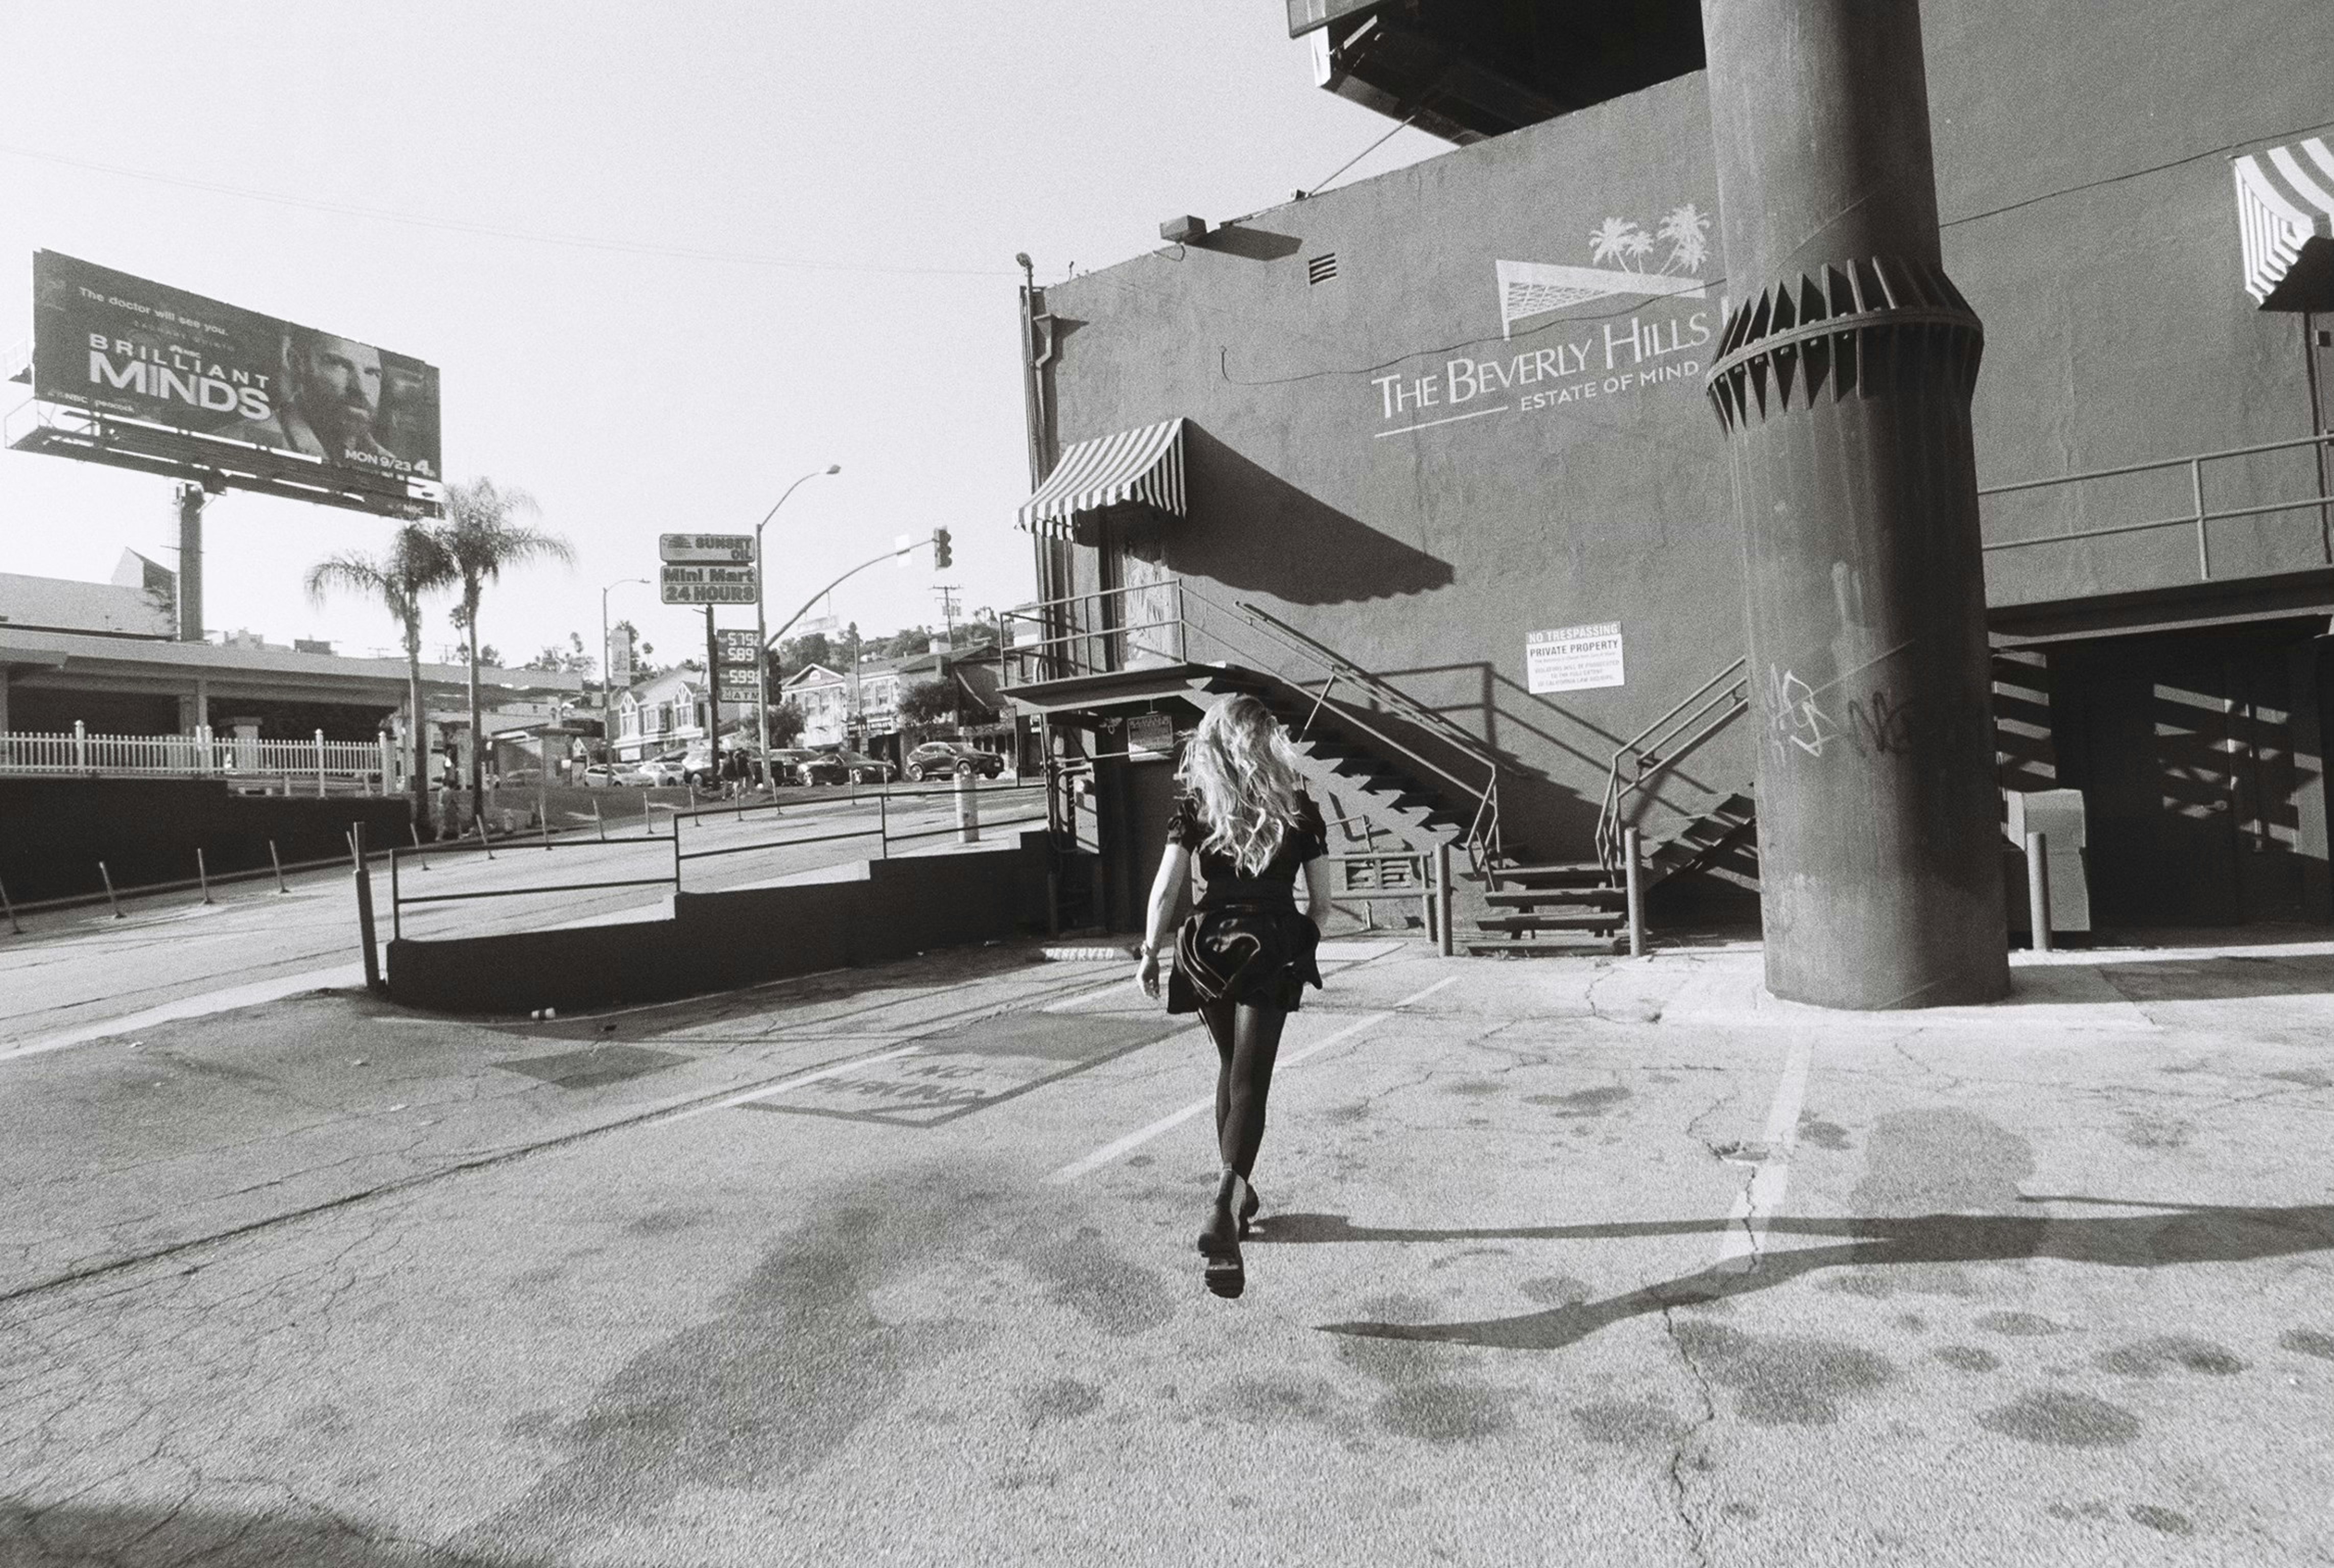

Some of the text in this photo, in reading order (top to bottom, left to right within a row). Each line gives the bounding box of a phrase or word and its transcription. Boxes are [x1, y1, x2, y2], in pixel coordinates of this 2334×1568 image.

[80, 287, 229, 336] The doctor will see you.
[90, 333, 270, 389] BRILLIANT
[1371, 312, 1711, 419] THE BEVERLY HILLS
[90, 350, 272, 420] MINDS
[1521, 361, 1699, 411] ESTATE OF MIND
[345, 449, 378, 465] MON
[379, 457, 412, 471] 9/23
[695, 537, 752, 549] SUNSET
[731, 549, 752, 559] OIL
[664, 568, 754, 582] Mini Mart
[666, 586, 755, 601] 24 HOURS
[1529, 624, 1618, 643] NO TRESPASSING
[728, 648, 754, 661] 589
[1530, 639, 1618, 657] PRIVATE PROPERTY
[1045, 947, 1114, 960] RESERVED
